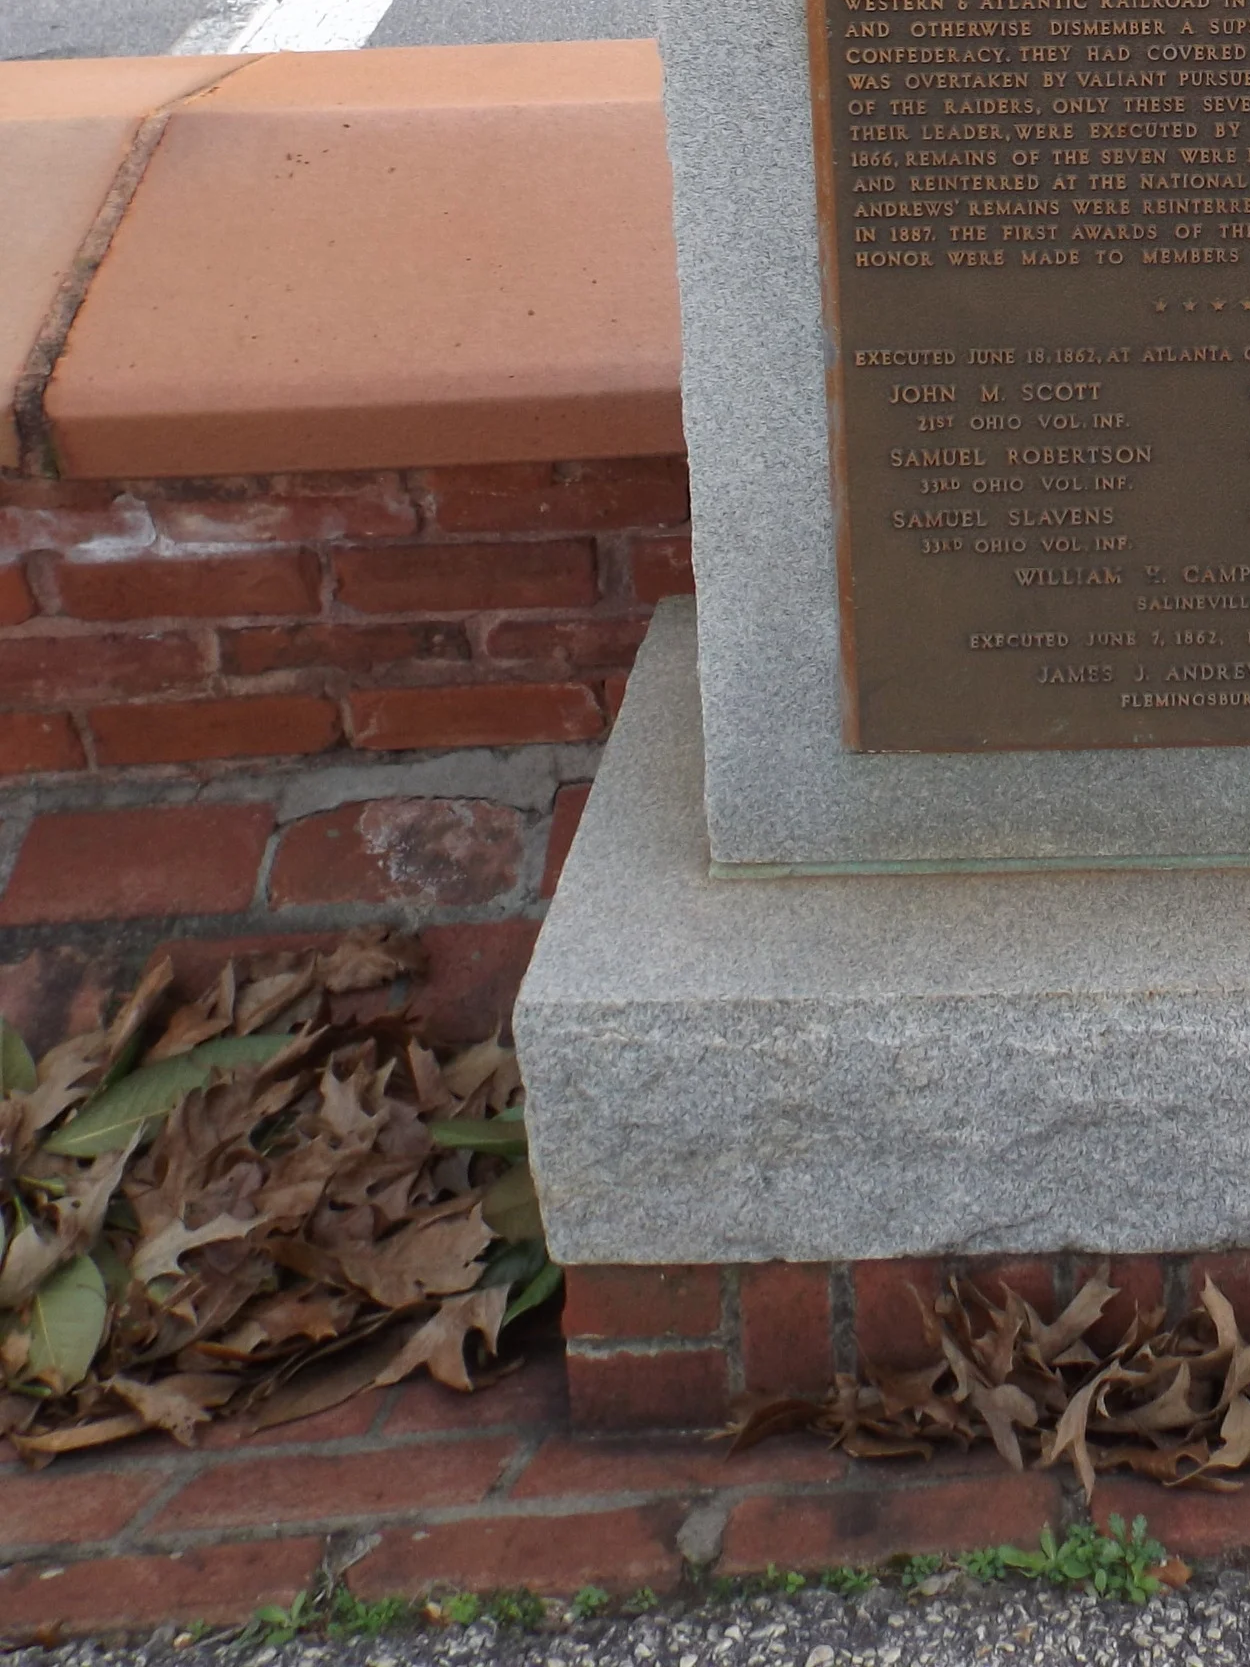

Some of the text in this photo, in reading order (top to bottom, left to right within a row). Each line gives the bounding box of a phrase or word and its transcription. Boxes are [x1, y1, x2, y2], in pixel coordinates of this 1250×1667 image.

[844, 21, 891, 37] AND
[909, 20, 1032, 37] OTHERWISE
[1049, 19, 1166, 35] DISMEMBER
[1180, 18, 1194, 33] A
[845, 46, 1011, 63] CONFEDERACY.
[1018, 44, 1072, 61] THEY
[1086, 45, 1131, 60] HAD
[1146, 43, 1247, 60] COVERED
[847, 74, 891, 89] WAS
[904, 71, 1029, 89] OVERTAKEN
[1042, 71, 1068, 87] BY
[1075, 70, 1167, 87] VALIANT
[847, 100, 876, 115] OF
[889, 98, 927, 115] THE
[943, 97, 1042, 115] RAIDERS,
[1051, 97, 1110, 113] ONLY
[1122, 96, 1186, 112] THESE
[855, 250, 934, 266] HONOR
[946, 249, 1005, 265] WERE
[1021, 249, 1080, 264] MADE
[1095, 248, 1124, 264] TO
[1142, 247, 1239, 263] MEMBERS
[889, 382, 1102, 403] JOHN M. SCOTT
[890, 446, 1152, 467] SAMUEL ROBERTSON
[893, 507, 1114, 527] SAMUEL SLAVENS
[1014, 567, 1122, 585] WILLIAM
[970, 632, 1069, 647] EXECUTED
[1088, 631, 1136, 645] JUNE
[1038, 665, 1113, 683] JAMES
